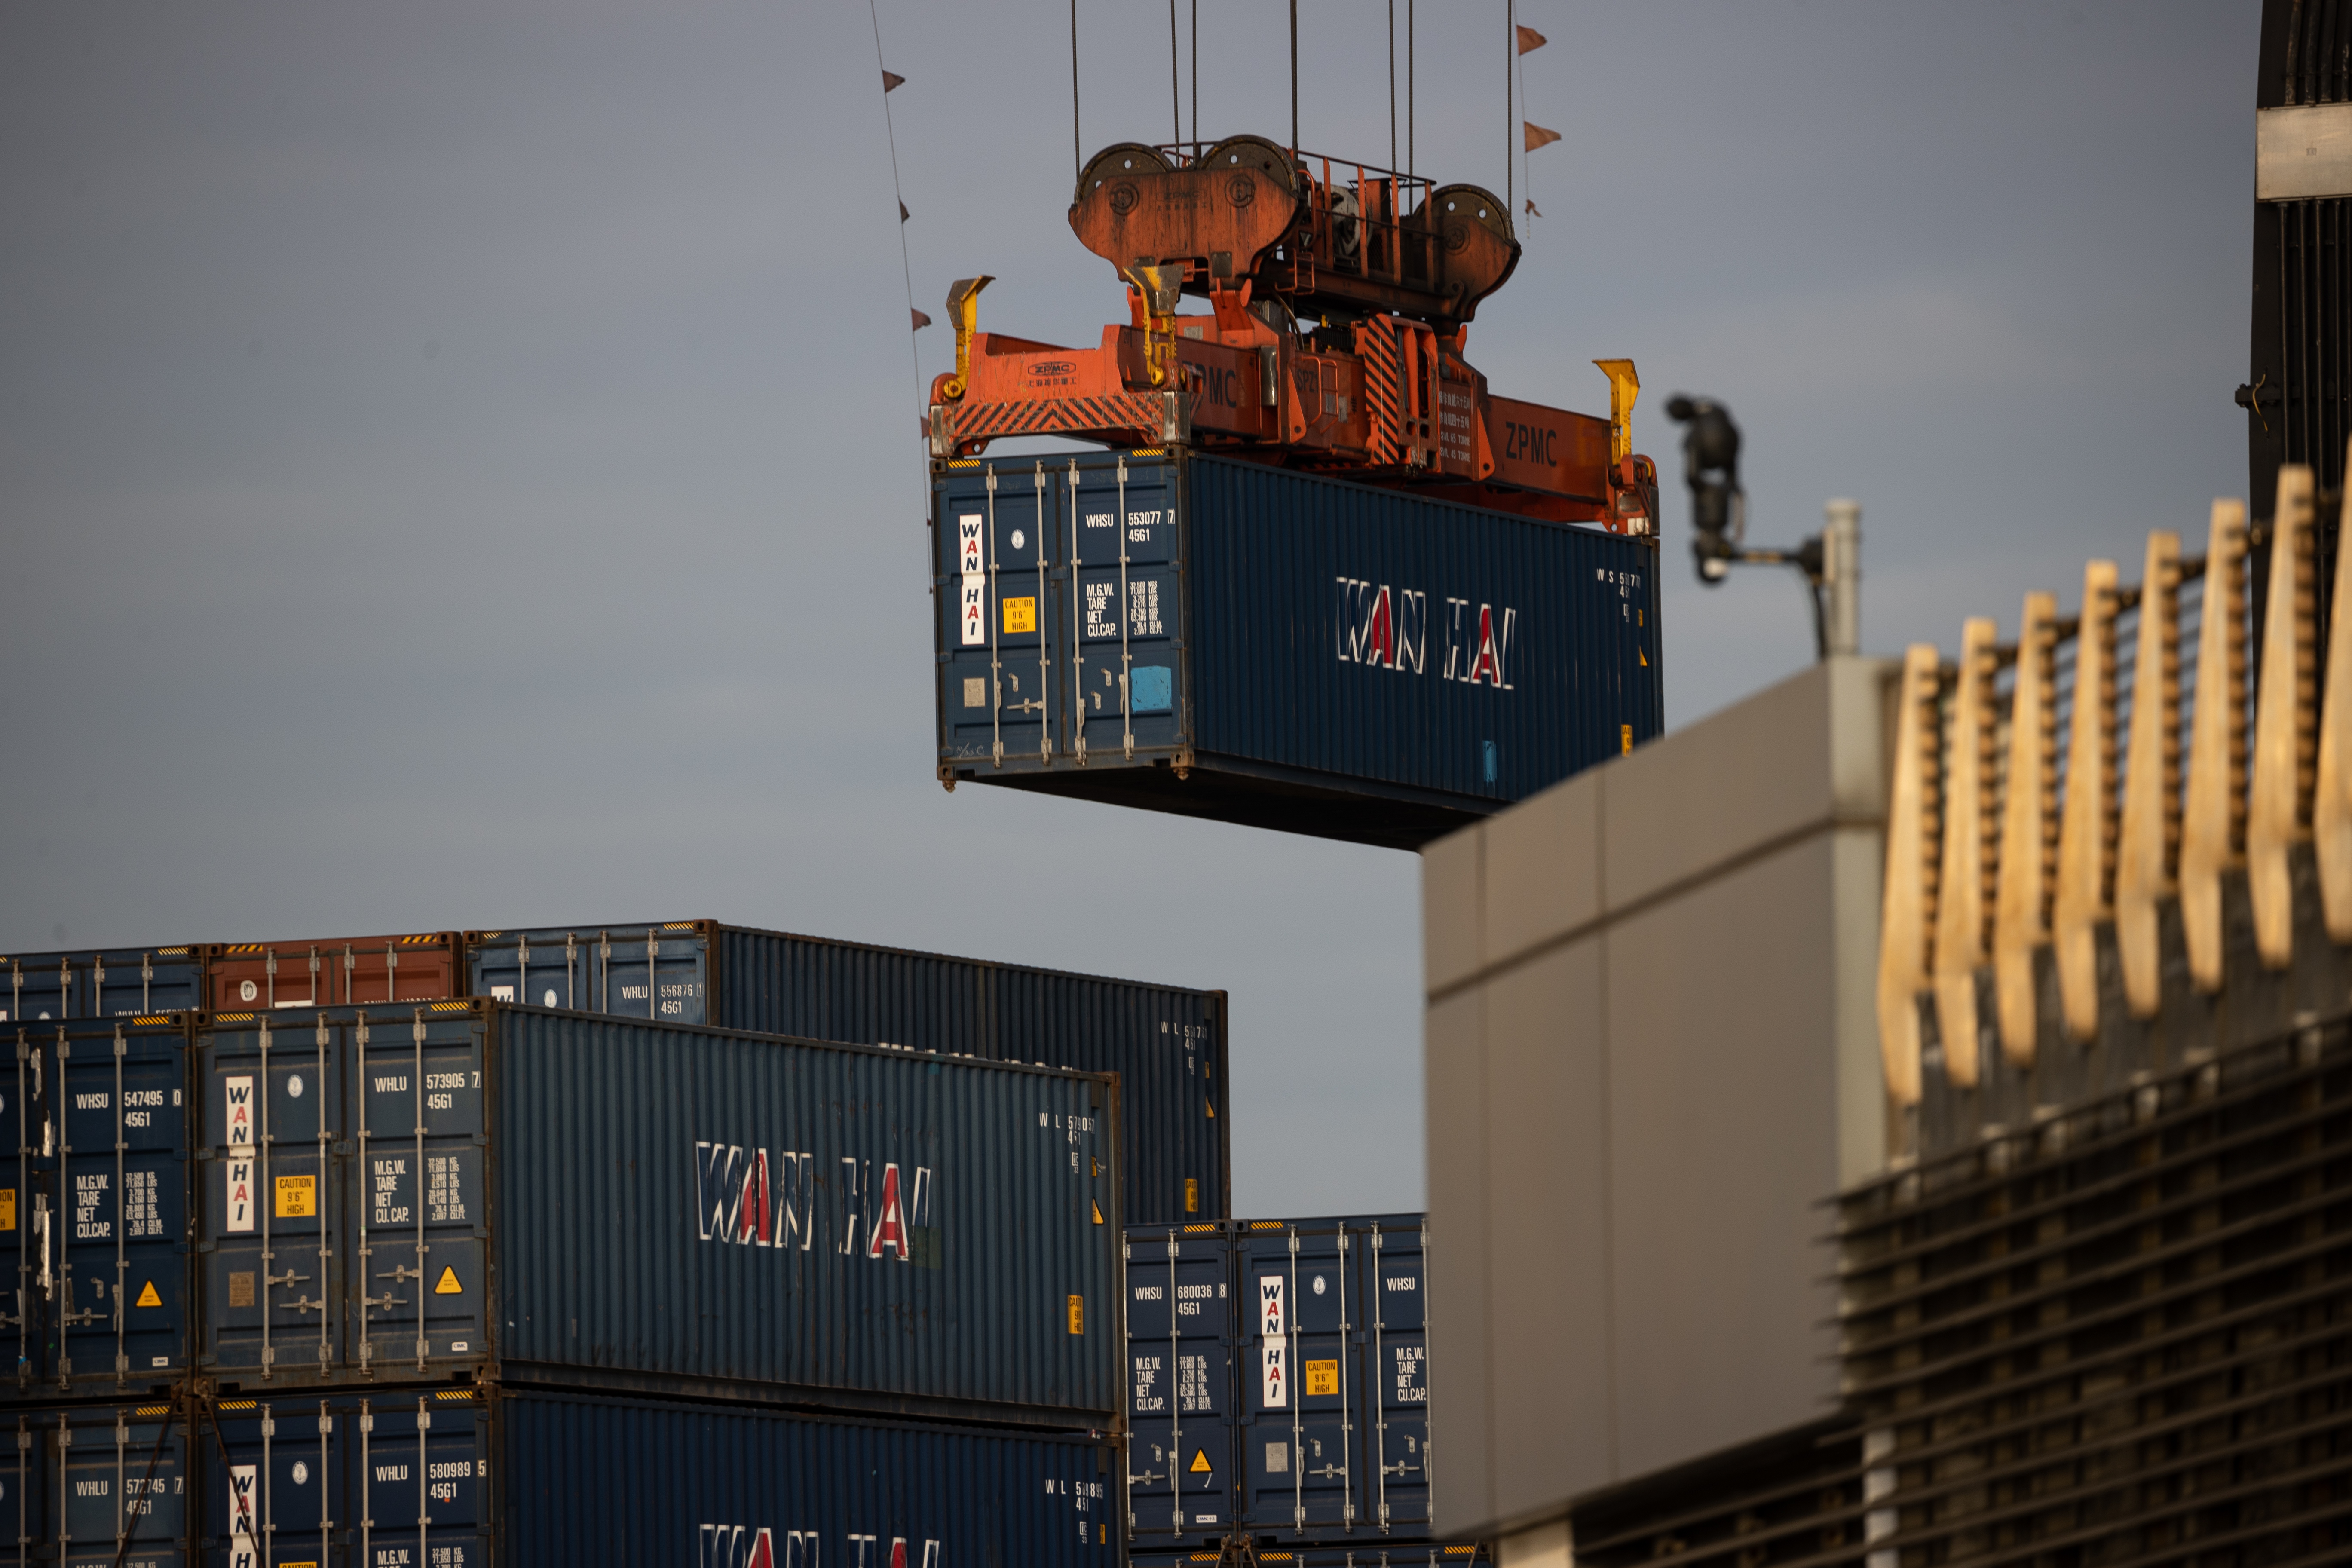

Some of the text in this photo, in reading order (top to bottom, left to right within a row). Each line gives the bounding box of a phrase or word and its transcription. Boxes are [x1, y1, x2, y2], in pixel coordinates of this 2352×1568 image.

[1035, 365, 1070, 374] ZPMC
[1441, 431, 1449, 442] SWL
[1458, 434, 1470, 447] TONNE
[1505, 421, 1557, 468] ZPMC
[1458, 450, 1470, 463] TONNE
[1086, 509, 1175, 528] WHSU 553077 7
[1129, 528, 1150, 542] 45G1
[962, 523, 980, 571] WAN
[1087, 583, 1114, 597] M.G.W.
[1005, 599, 1033, 609] CAUTION
[1087, 597, 1106, 610] TARE
[966, 589, 979, 636] HAI
[1087, 610, 1102, 624] NET
[1012, 622, 1027, 631] HIGH
[1088, 623, 1116, 637] CU.CAP.
[1336, 577, 1426, 674] WAN
[622, 986, 648, 999] WHLU
[661, 984, 693, 997] 556876
[661, 1001, 682, 1014] 45G1
[374, 1071, 480, 1093] WHLU 573905 7
[77, 1093, 108, 1109] WHSU
[124, 1090, 163, 1107] 547495
[427, 1093, 452, 1109] 45G1
[125, 1112, 150, 1127] 45G1
[229, 1087, 250, 1143] WAN
[375, 1160, 406, 1175] M.G.W.
[77, 1174, 109, 1190] M.G.W.
[280, 1178, 311, 1189] CAUTION
[375, 1176, 397, 1191] TARE
[77, 1191, 100, 1206] TARE
[233, 1164, 248, 1221] HAI
[375, 1192, 392, 1207] NET
[696, 1141, 813, 1250] WAN
[77, 1207, 95, 1222] NET
[287, 1204, 304, 1214] HIGH
[77, 1222, 110, 1238] CU.CAP.
[1136, 1283, 1226, 1300] WHSU 680036 8
[1387, 1277, 1415, 1291] WHSU
[1178, 1302, 1200, 1315] 45G1
[1262, 1285, 1280, 1333] WAN
[1396, 1347, 1424, 1360] M.G.W.
[1136, 1357, 1160, 1370] M.G.W.
[1308, 1361, 1335, 1371] CAUTION
[1397, 1361, 1416, 1374] TARE
[1136, 1371, 1155, 1384] TARE
[1268, 1350, 1281, 1398] HAI
[1397, 1375, 1412, 1387] NET
[1136, 1384, 1150, 1397] NET
[1315, 1384, 1329, 1393] HIGH
[376, 1460, 486, 1482] WHLU 580989 5
[76, 1480, 108, 1496] WHLU
[175, 1477, 183, 1494] 7
[430, 1482, 456, 1499] 45G1
[234, 1476, 254, 1533] WAN
[377, 1549, 410, 1565] M.G.W.
[454, 1547, 462, 1555] KG
[454, 1555, 464, 1563] LBS
